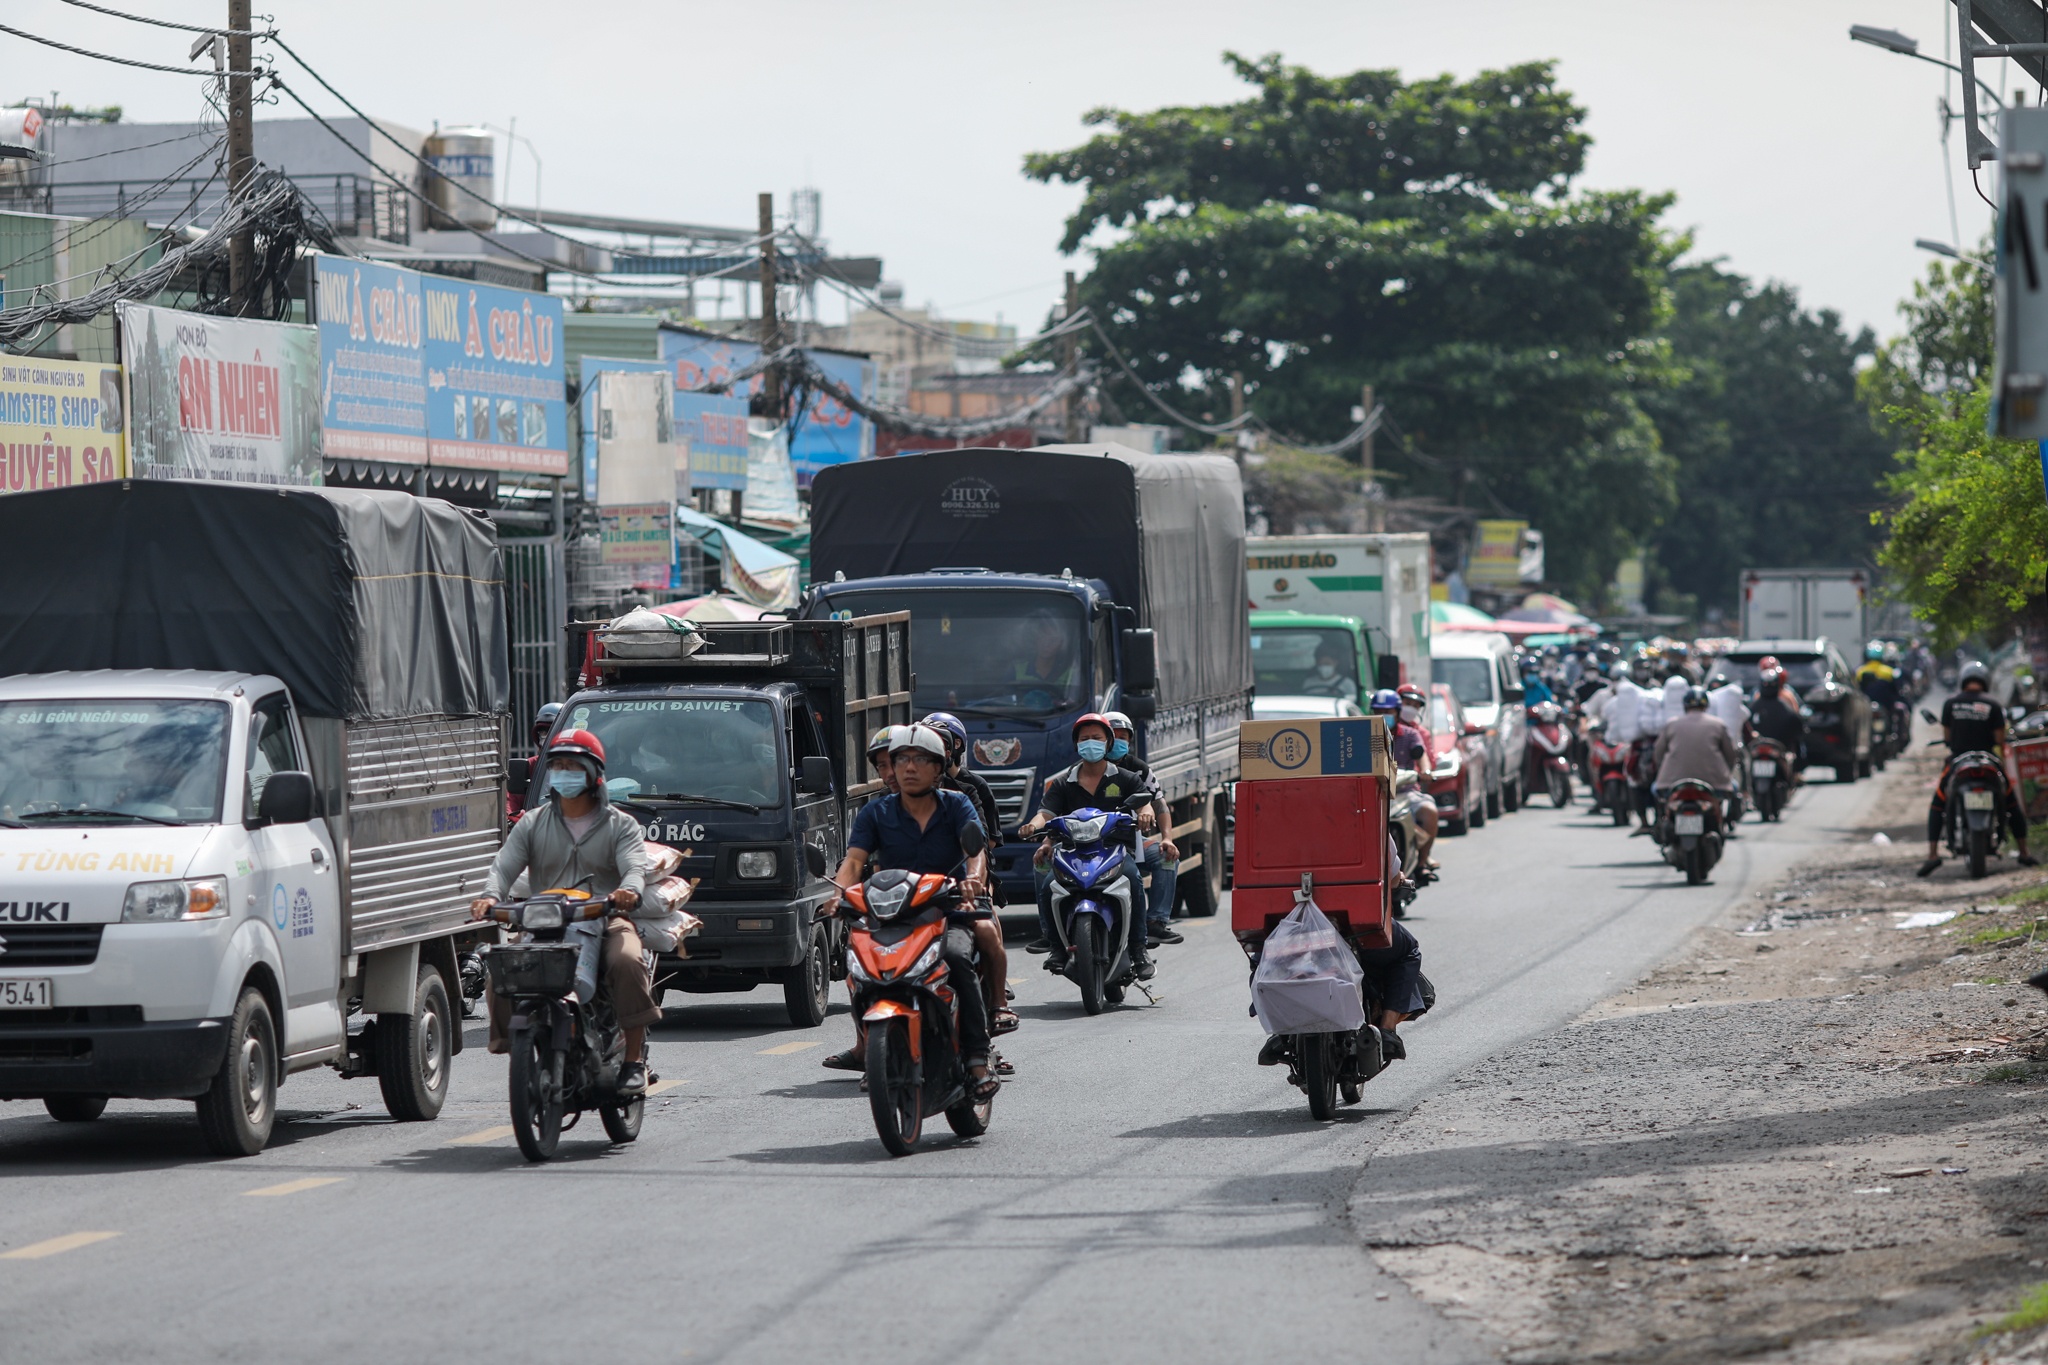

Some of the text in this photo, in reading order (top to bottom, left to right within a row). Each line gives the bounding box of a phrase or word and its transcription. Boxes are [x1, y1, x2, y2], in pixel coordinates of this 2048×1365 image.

[319, 267, 420, 349] INOX Á CHÂU
[195, 322, 207, 354] BỘ
[426, 289, 461, 342] INOX
[465, 289, 484, 358] Á
[488, 297, 553, 367] CHÂU
[2, 366, 17, 383] SINH
[50, 369, 76, 388] NGUYÊN
[77, 372, 85, 388] SA
[178, 348, 281, 441] AN NHIÊN
[61, 396, 100, 430] SHOP
[82, 446, 114, 484] SA
[951, 487, 990, 502] HUY
[17, 710, 149, 724] SÀI GÒN NGÔI SAO
[599, 702, 665, 712] SUZUKI
[1285, 736, 1294, 761] 555
[666, 819, 705, 842] RÁC
[16, 849, 174, 874] TÙNG ANH
